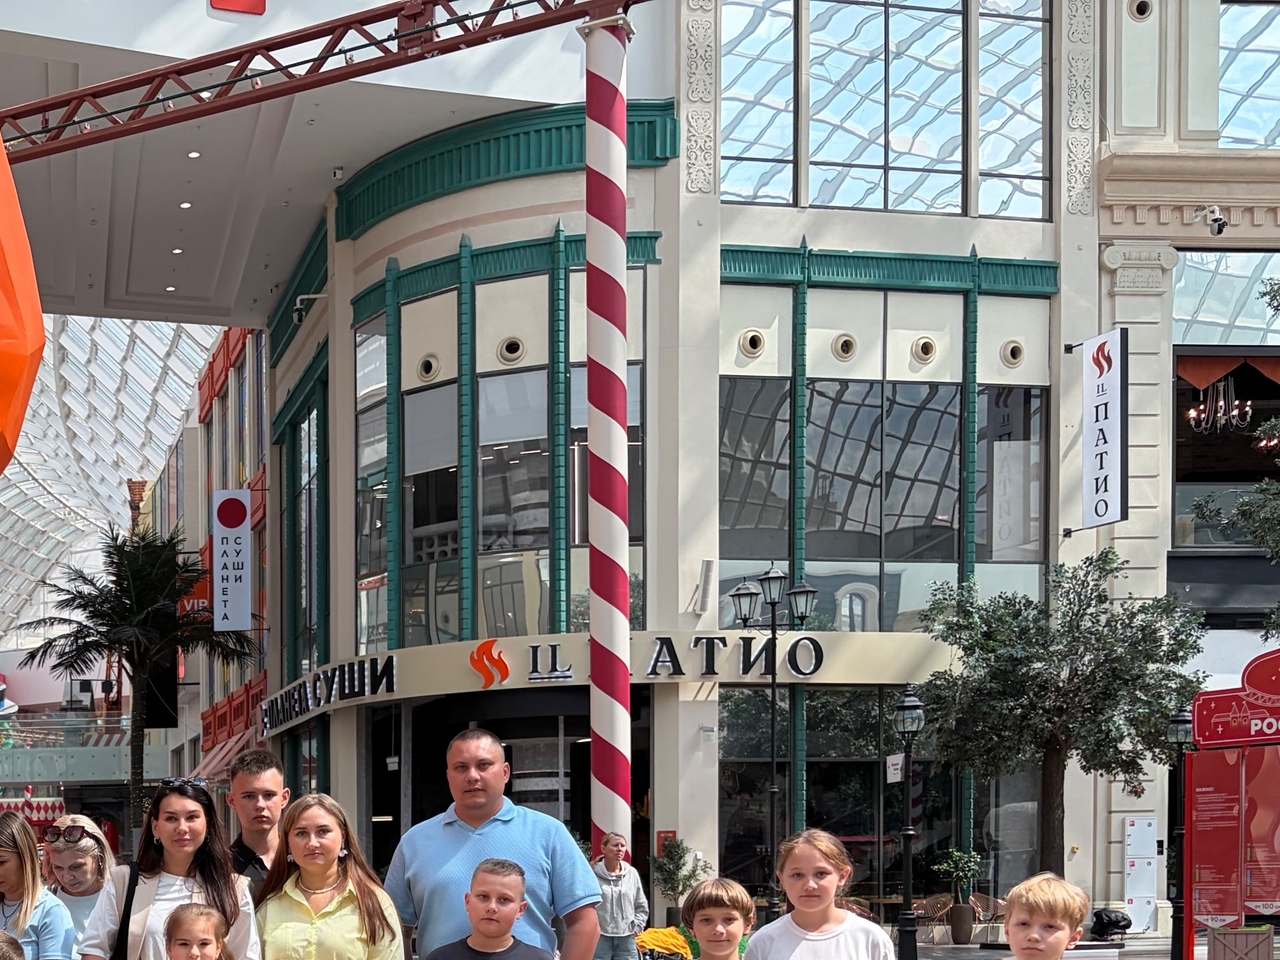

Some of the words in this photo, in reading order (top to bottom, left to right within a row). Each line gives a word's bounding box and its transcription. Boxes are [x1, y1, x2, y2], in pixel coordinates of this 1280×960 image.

[1094, 401, 1110, 518] ПАТИО
[221, 537, 229, 621] ПЛАНЕТА
[233, 537, 244, 583] СУШИ
[313, 655, 395, 707] СУШИ
[588, 636, 824, 677] АТИО
[1250, 717, 1280, 735] РО
